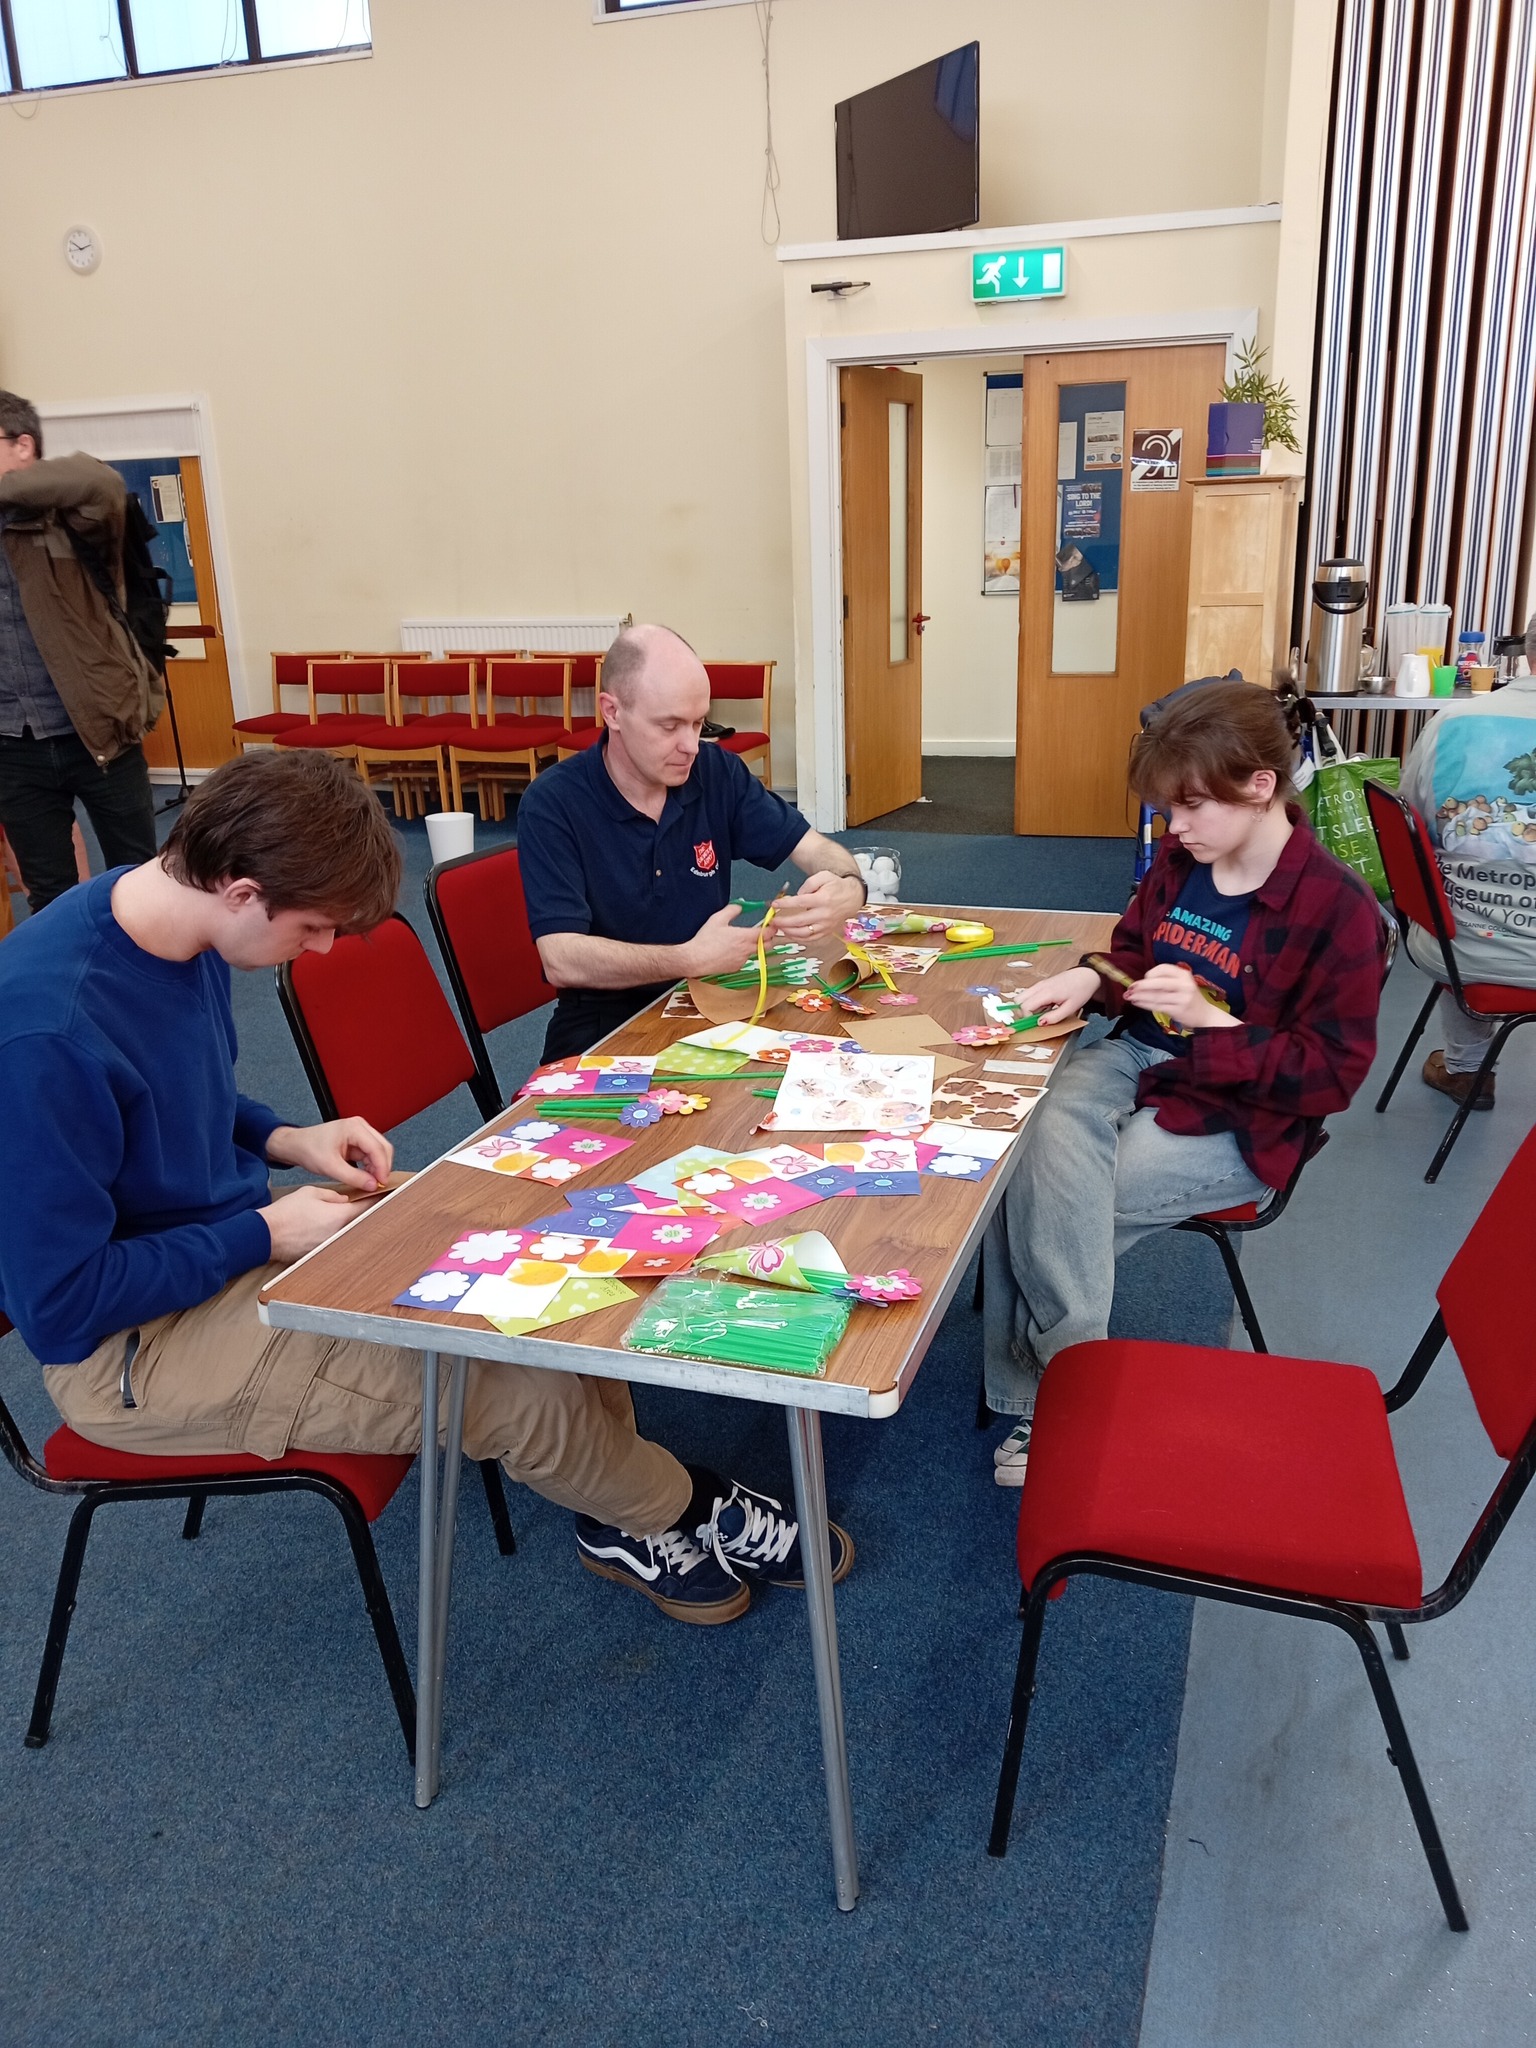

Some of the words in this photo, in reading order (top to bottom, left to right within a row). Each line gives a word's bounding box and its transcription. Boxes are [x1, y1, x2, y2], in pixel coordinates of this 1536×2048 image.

[1166, 465, 1176, 476] T
[1081, 492, 1090, 500] TO
[1090, 492, 1102, 500] THE
[1444, 880, 1513, 906] useum
[1170, 906, 1233, 942] AMAZING
[1152, 921, 1241, 979] PIDER-MAN
